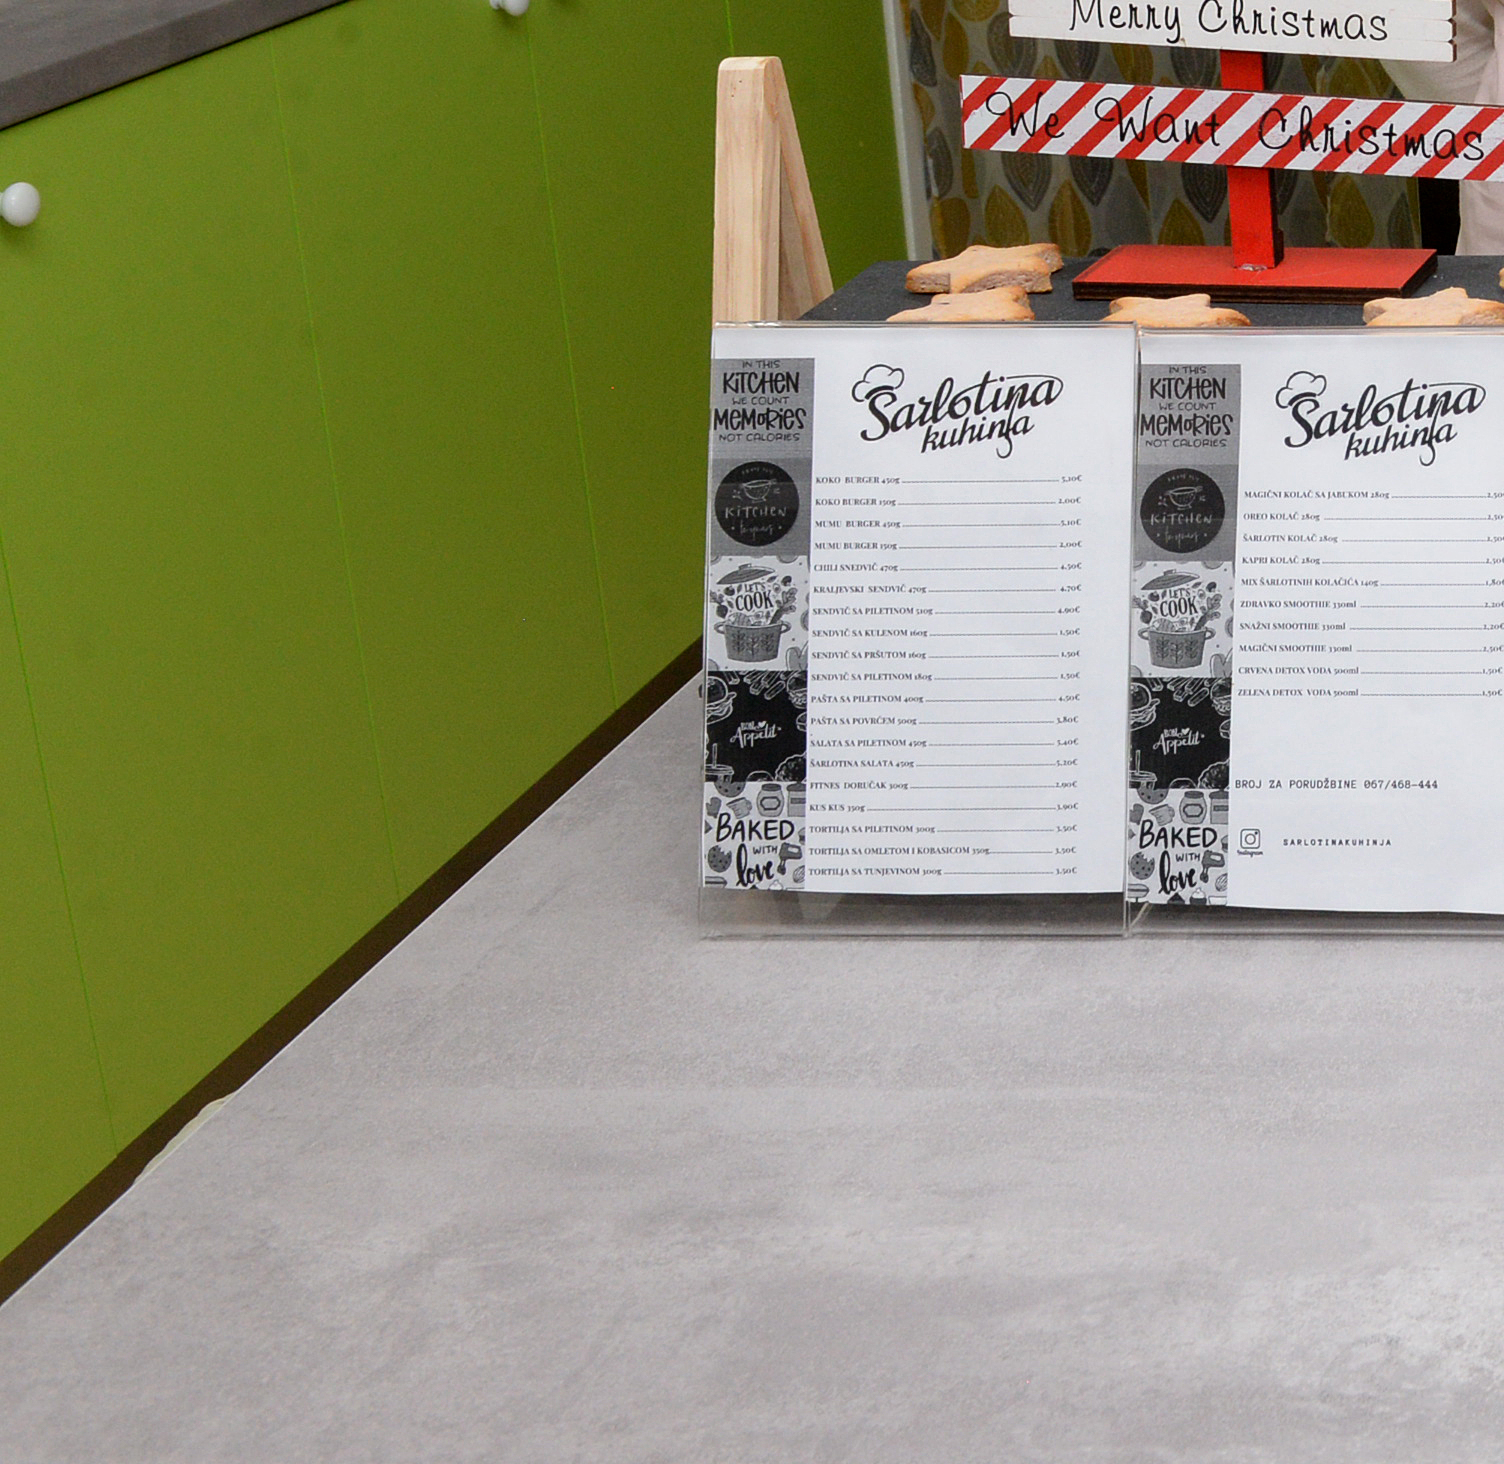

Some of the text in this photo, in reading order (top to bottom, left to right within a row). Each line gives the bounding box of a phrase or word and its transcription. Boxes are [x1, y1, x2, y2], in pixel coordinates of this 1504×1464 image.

[986, 92, 1485, 162] We Want Christmas
[742, 360, 780, 369] IN THIS
[1169, 365, 1207, 374] IN THIS
[732, 396, 790, 405] WE COUNT
[1158, 402, 1217, 411] WE COUNT
[719, 433, 800, 442] NOT CALORIES
[1145, 439, 1227, 447] NOT CALORIES
[815, 476, 841, 484] KOKO
[845, 476, 880, 484] BURGER
[1244, 490, 1282, 499] MAGIČNI
[1283, 489, 1313, 499] KOLAČ
[1315, 491, 1327, 499] SA
[1327, 491, 1369, 500] JABUKOM
[1243, 512, 1268, 520] OREO
[1269, 511, 1300, 521] KOLAČ
[846, 520, 880, 528] BURGER
[1242, 556, 1268, 564] KAPRI
[1269, 555, 1300, 564] KOLAČ
[1241, 578, 1258, 586] MIX
[813, 586, 864, 594] KRALJEVSKI
[868, 584, 906, 593] SENDVIČ
[735, 590, 774, 612] COOK
[1240, 600, 1282, 608] ZDRAVKO
[1283, 600, 1331, 608] SMOOTHIE
[1160, 596, 1198, 618] COOK
[1239, 621, 1271, 630] SNAŽNI
[1272, 622, 1320, 630] SMOOTHIE
[812, 650, 849, 659] SENDVIČ
[864, 650, 906, 659] PRŠUTOM
[1238, 666, 1273, 674] CRVENA
[1274, 666, 1306, 674] DETOX
[1307, 666, 1332, 674] VODA
[811, 694, 838, 703] PAŠTA
[840, 695, 851, 703] SA
[853, 695, 901, 703] PILETINOM
[810, 759, 859, 768] ŠARLOTINA
[860, 760, 894, 768] SALATA
[1235, 780, 1262, 790] BROJ
[1269, 780, 1282, 789] ZA
[1289, 777, 1357, 789] PORUDŽBINE
[809, 804, 826, 812] KUS
[828, 804, 845, 812] KUS
[716, 812, 795, 842] BAKED
[1139, 819, 1217, 849] BAKED
[753, 845, 778, 855] WITH
[1175, 853, 1201, 862] WITH
[736, 843, 774, 887] love
[809, 868, 850, 877] TORTILJA
[852, 868, 863, 876] SA
[864, 868, 920, 877] TUNJEVINOM
[1158, 850, 1197, 895] love
